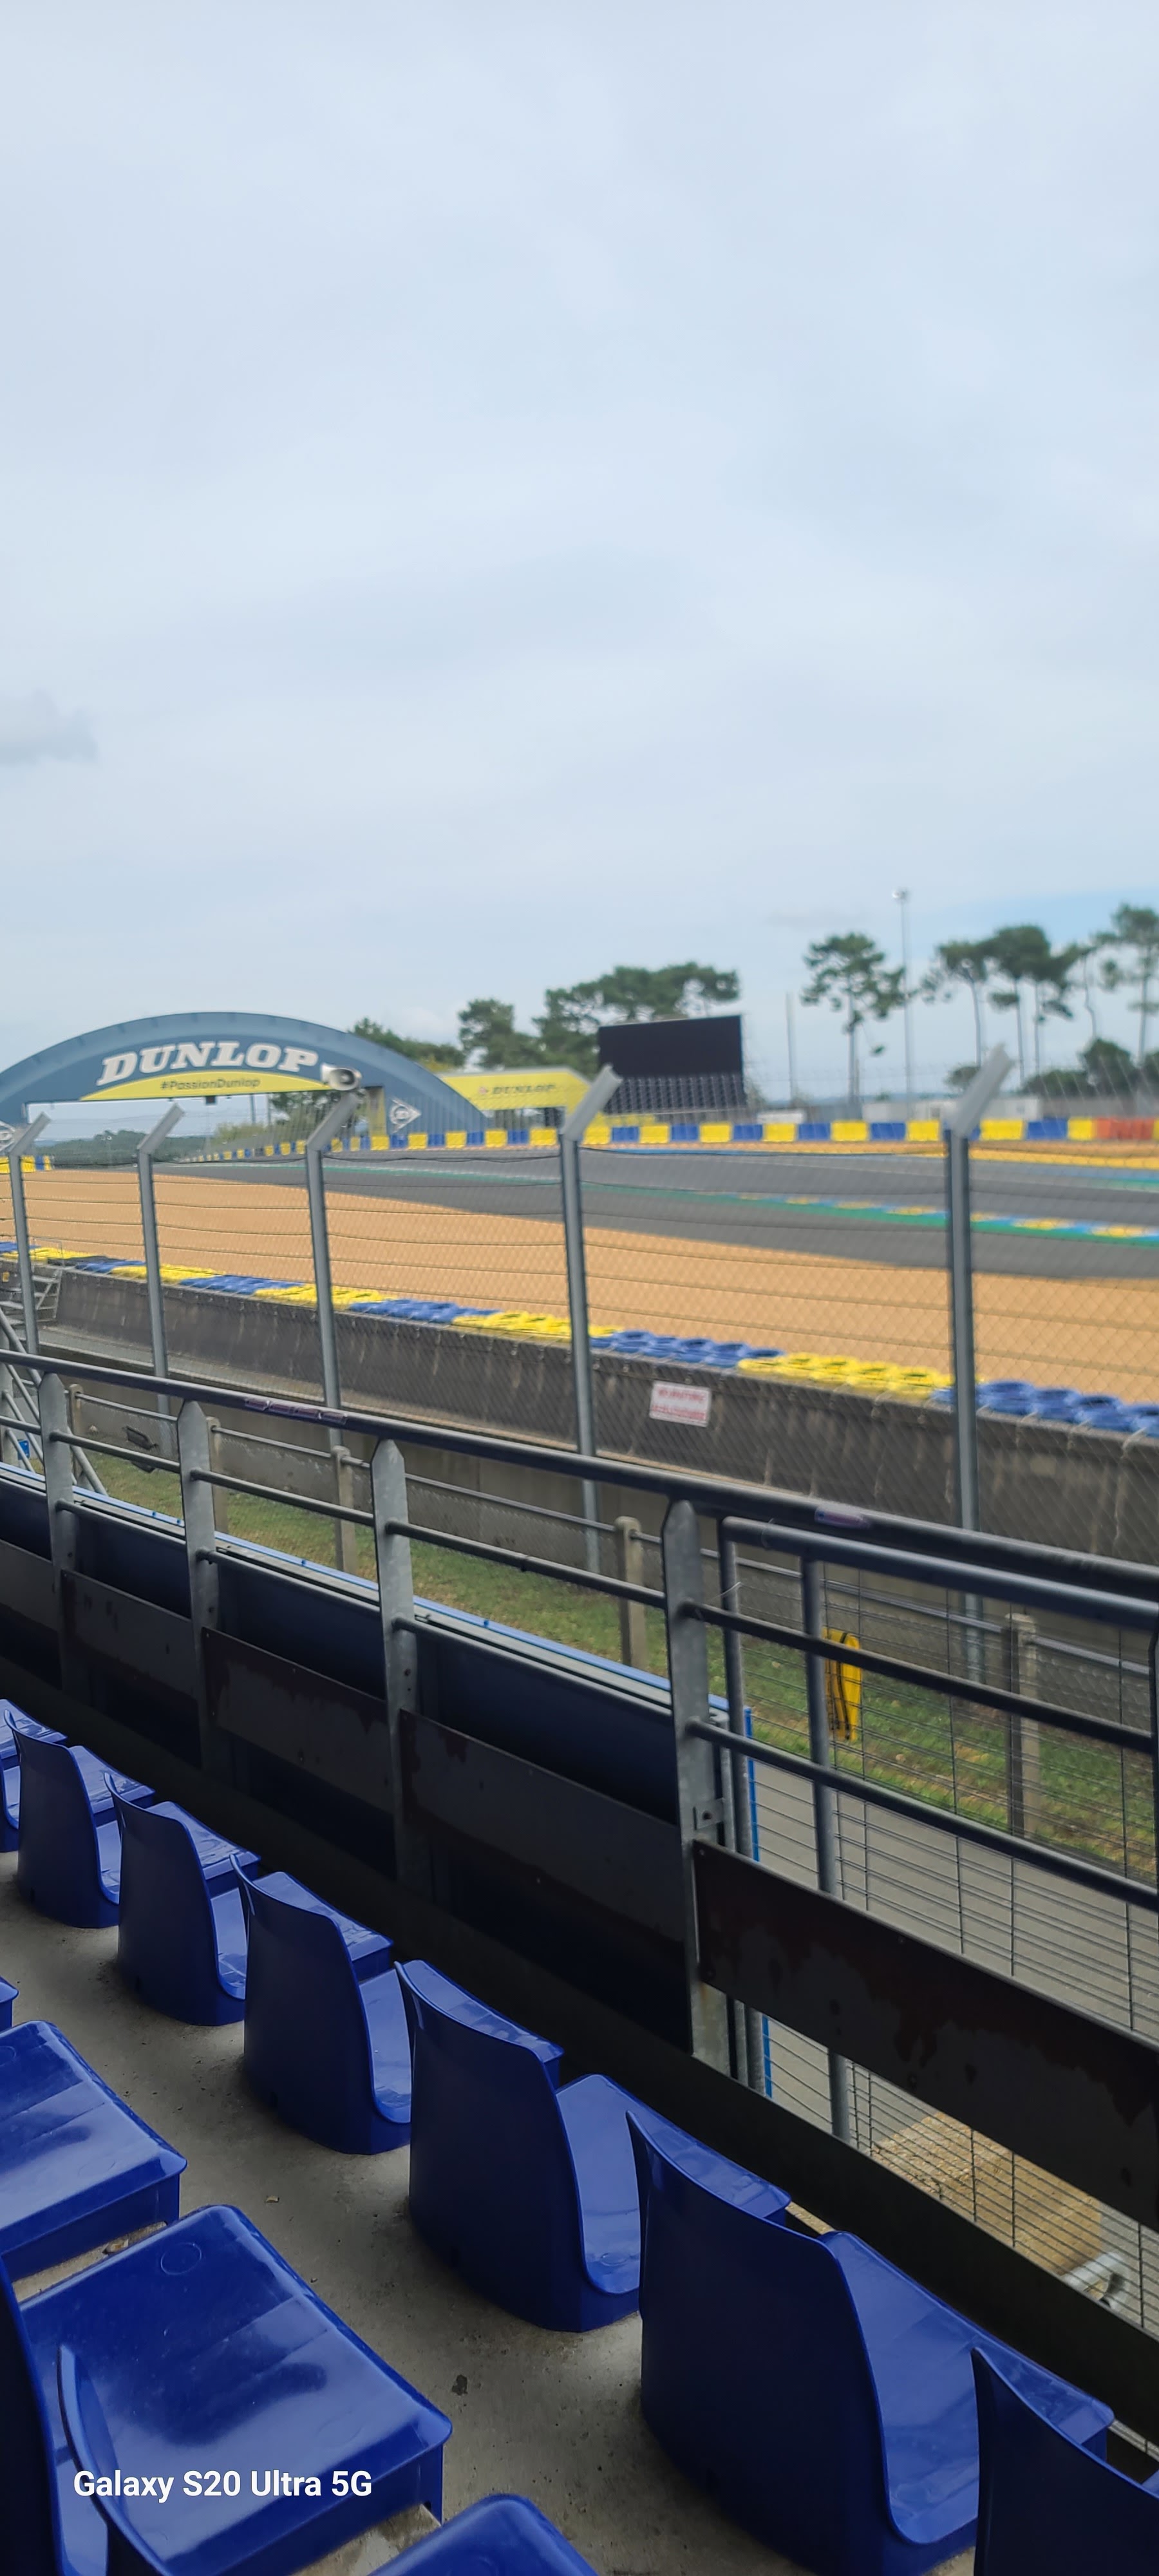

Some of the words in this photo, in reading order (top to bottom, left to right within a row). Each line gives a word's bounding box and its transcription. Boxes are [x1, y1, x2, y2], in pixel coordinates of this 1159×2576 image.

[97, 1041, 319, 1086] DUNLOP
[161, 1077, 261, 1090] #PassionDunlop
[493, 1084, 556, 1094] DUNLOP
